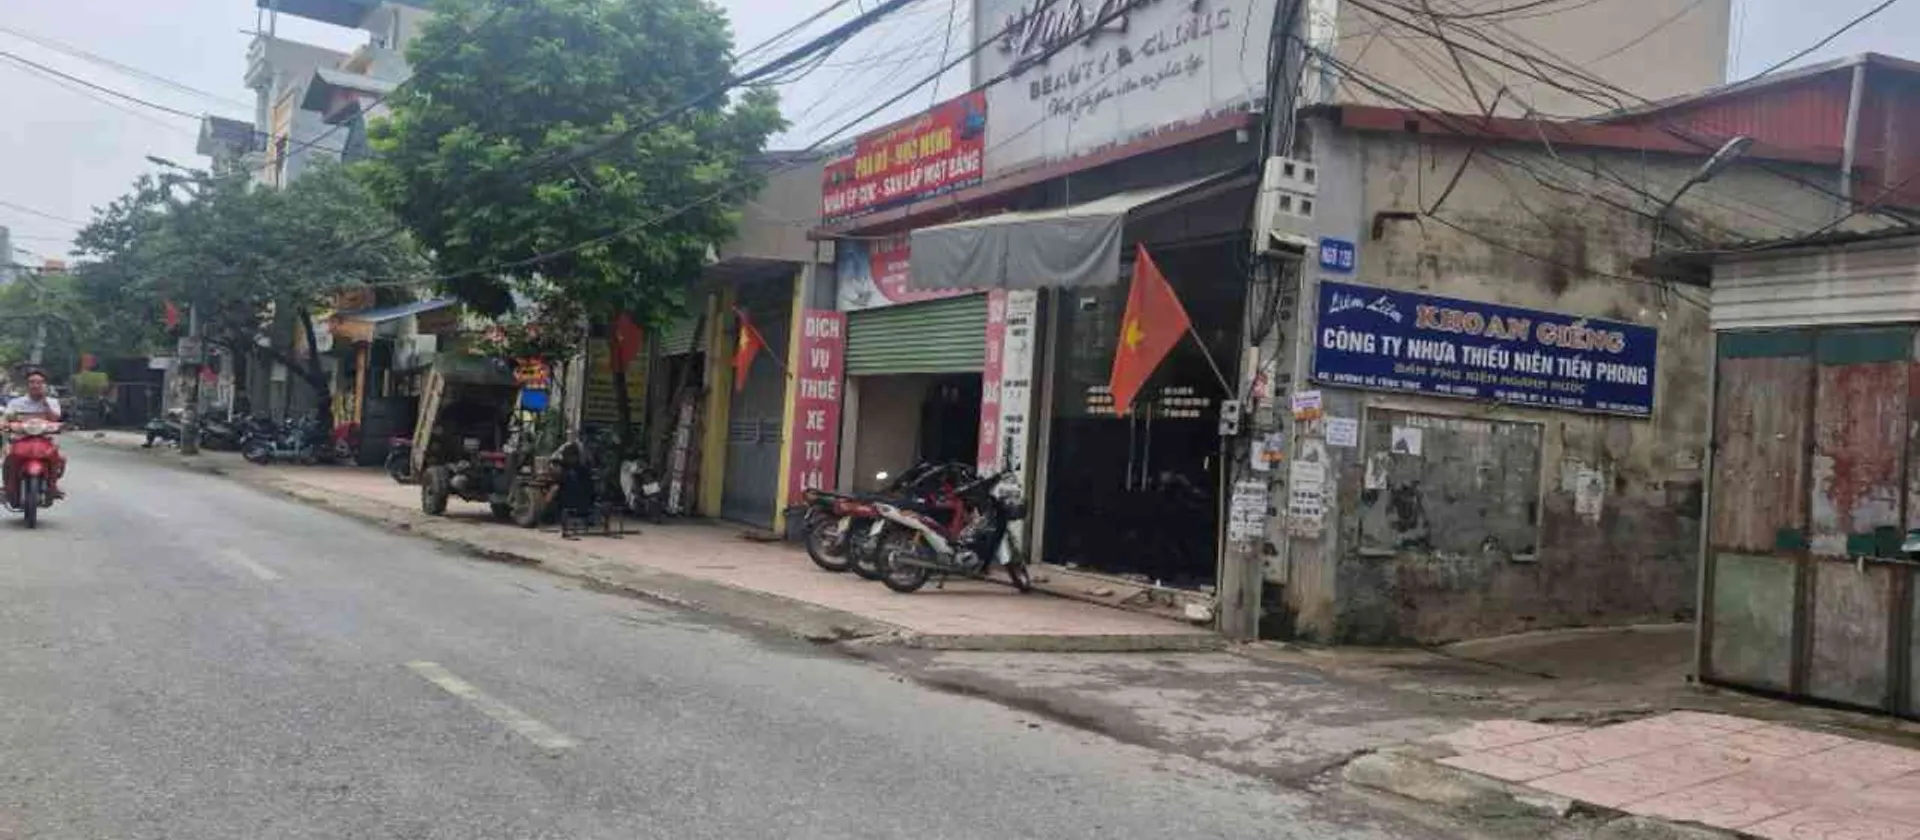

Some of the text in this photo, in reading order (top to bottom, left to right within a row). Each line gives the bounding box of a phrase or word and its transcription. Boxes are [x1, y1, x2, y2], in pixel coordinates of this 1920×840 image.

[1030, 52, 1110, 100] BEAUTY
[1142, 9, 1232, 57] CLINIC
[805, 317, 840, 342] DỊCH
[1415, 304, 1625, 353] KHOAN GIẾNG
[811, 347, 830, 373] VỤ
[1323, 325, 1376, 354] CÔNG
[1381, 335, 1402, 357] TY
[1406, 338, 1456, 366] NHỰA
[1462, 344, 1510, 370] THIẾU
[1514, 350, 1553, 376] NIÊN
[1596, 361, 1648, 386] PHONG
[800, 376, 837, 400] THUÊ
[806, 410, 826, 431] XE
[800, 466, 823, 492] LÁI
